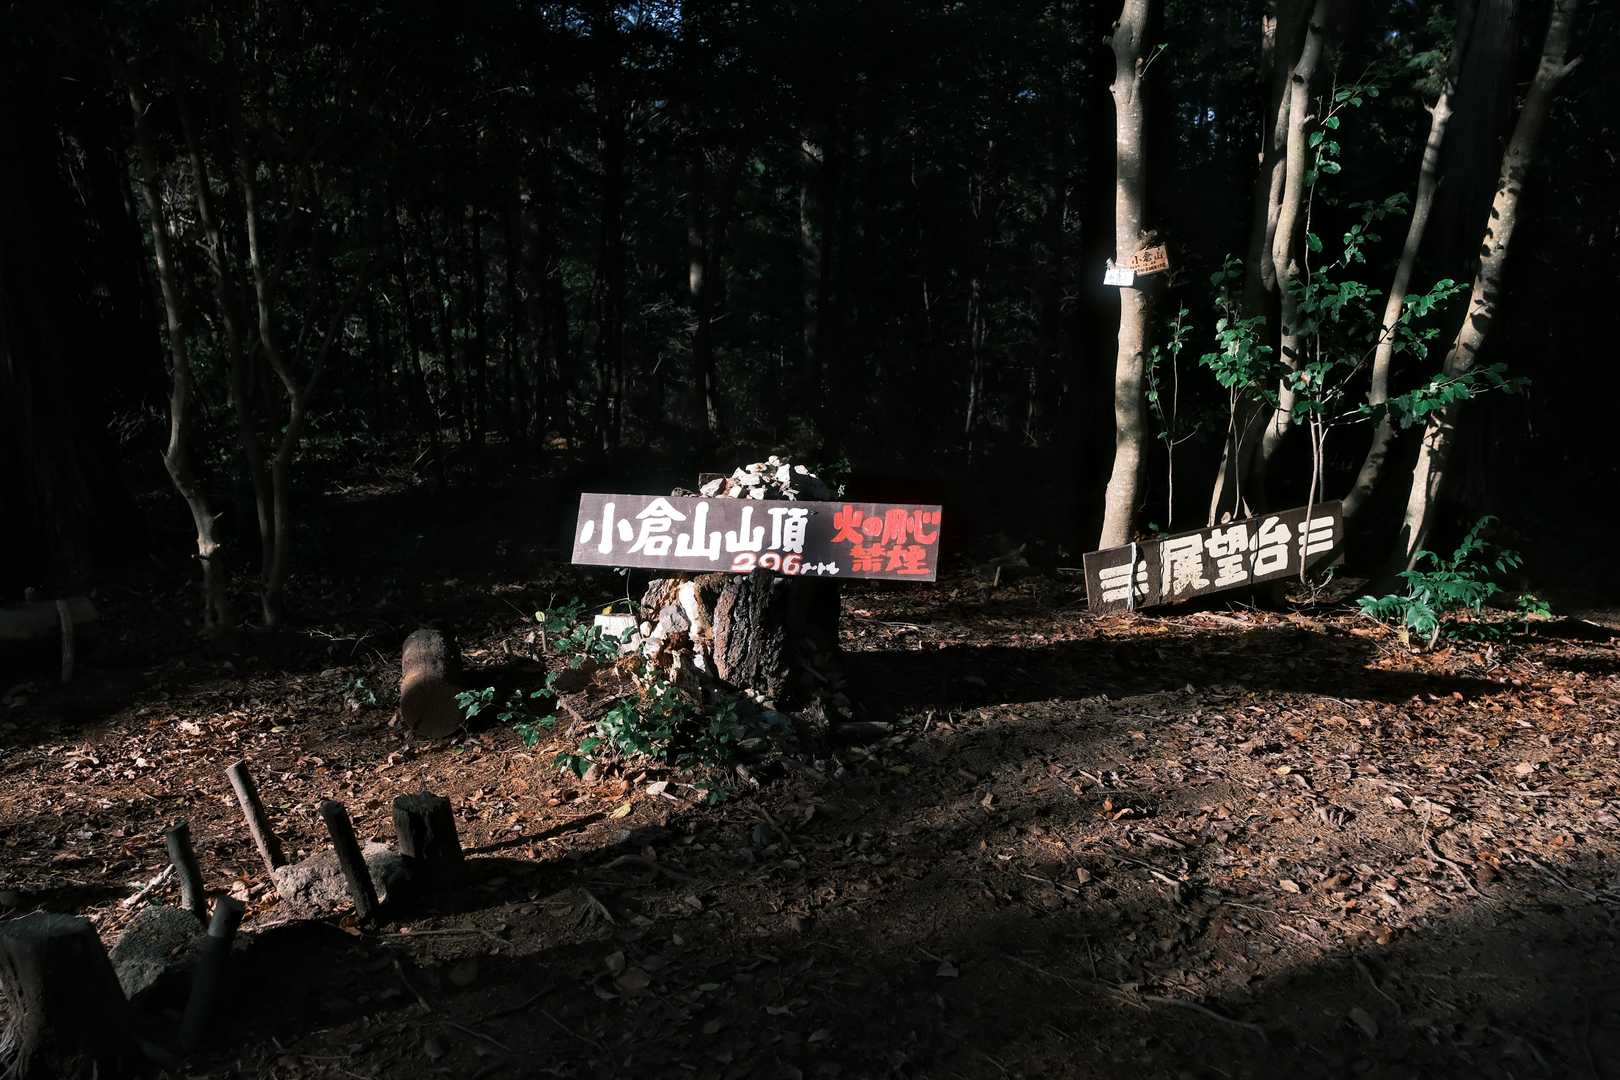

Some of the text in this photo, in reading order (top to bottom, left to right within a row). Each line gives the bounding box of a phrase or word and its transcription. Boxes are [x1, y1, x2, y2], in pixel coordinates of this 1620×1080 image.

[579, 497, 809, 562] 小倉山山頂
[830, 504, 942, 546] 火の用心
[850, 542, 930, 575] 禁煙
[1160, 516, 1292, 598] 展望台
